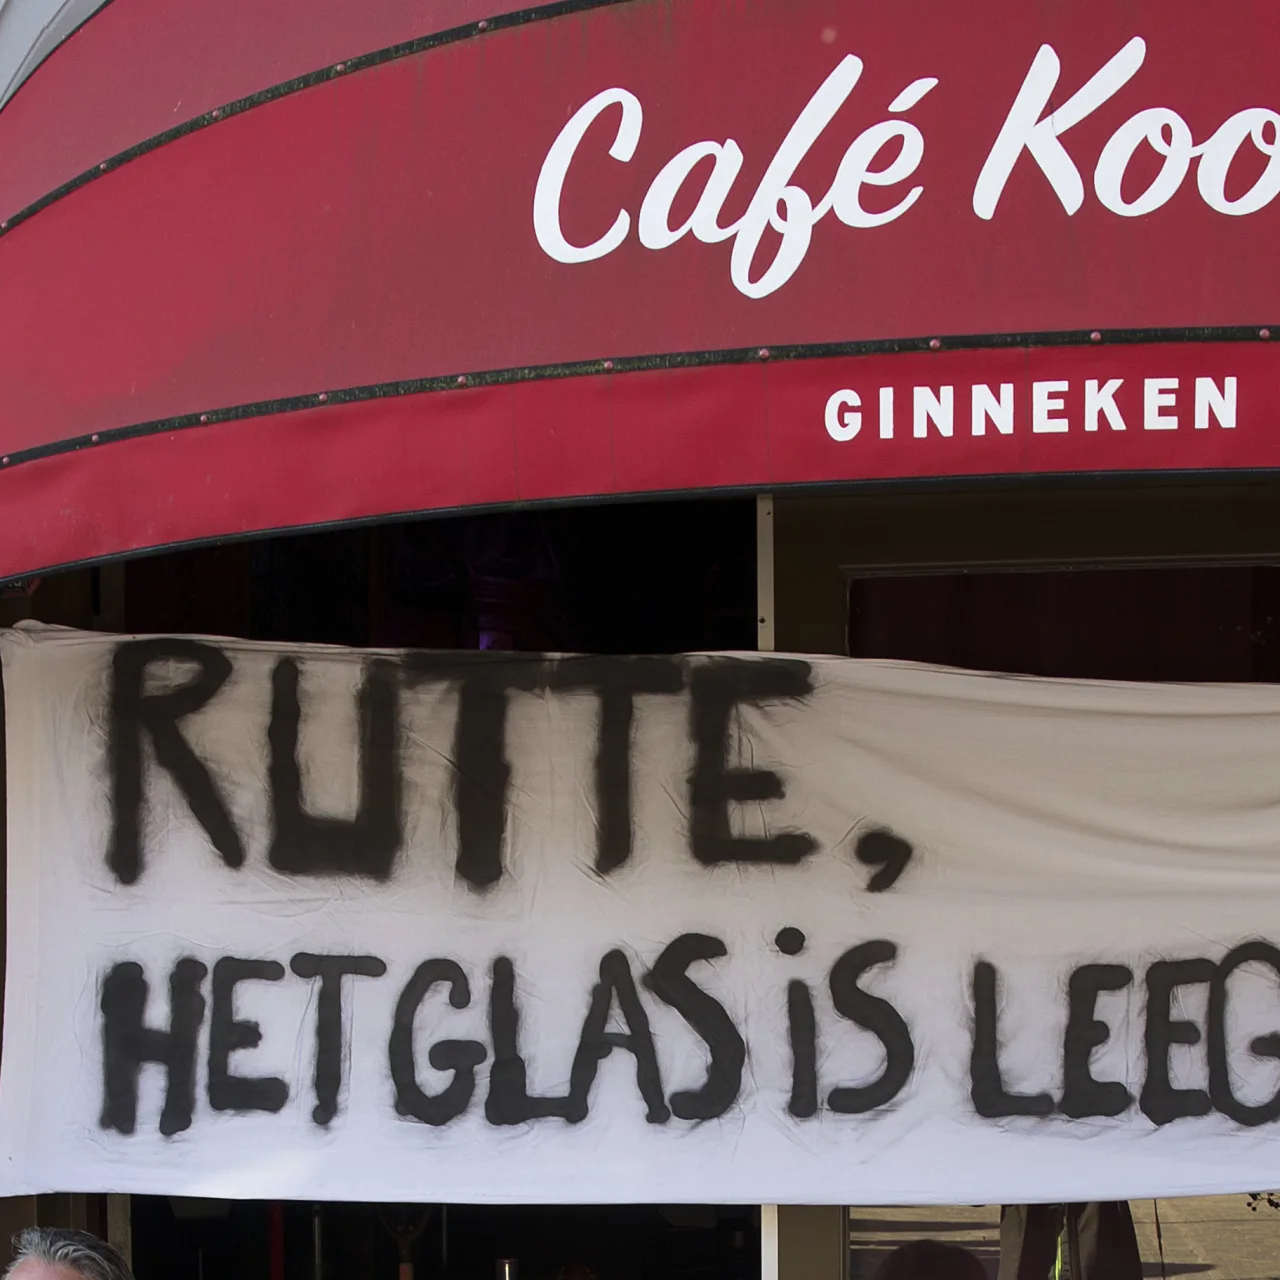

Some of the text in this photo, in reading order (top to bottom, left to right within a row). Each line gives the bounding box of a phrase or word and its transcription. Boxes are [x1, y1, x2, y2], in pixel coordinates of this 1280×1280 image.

[533, 53, 939, 299] Café
[825, 376, 1237, 442] GINNEKEN
[105, 638, 913, 893] RUTTE,
